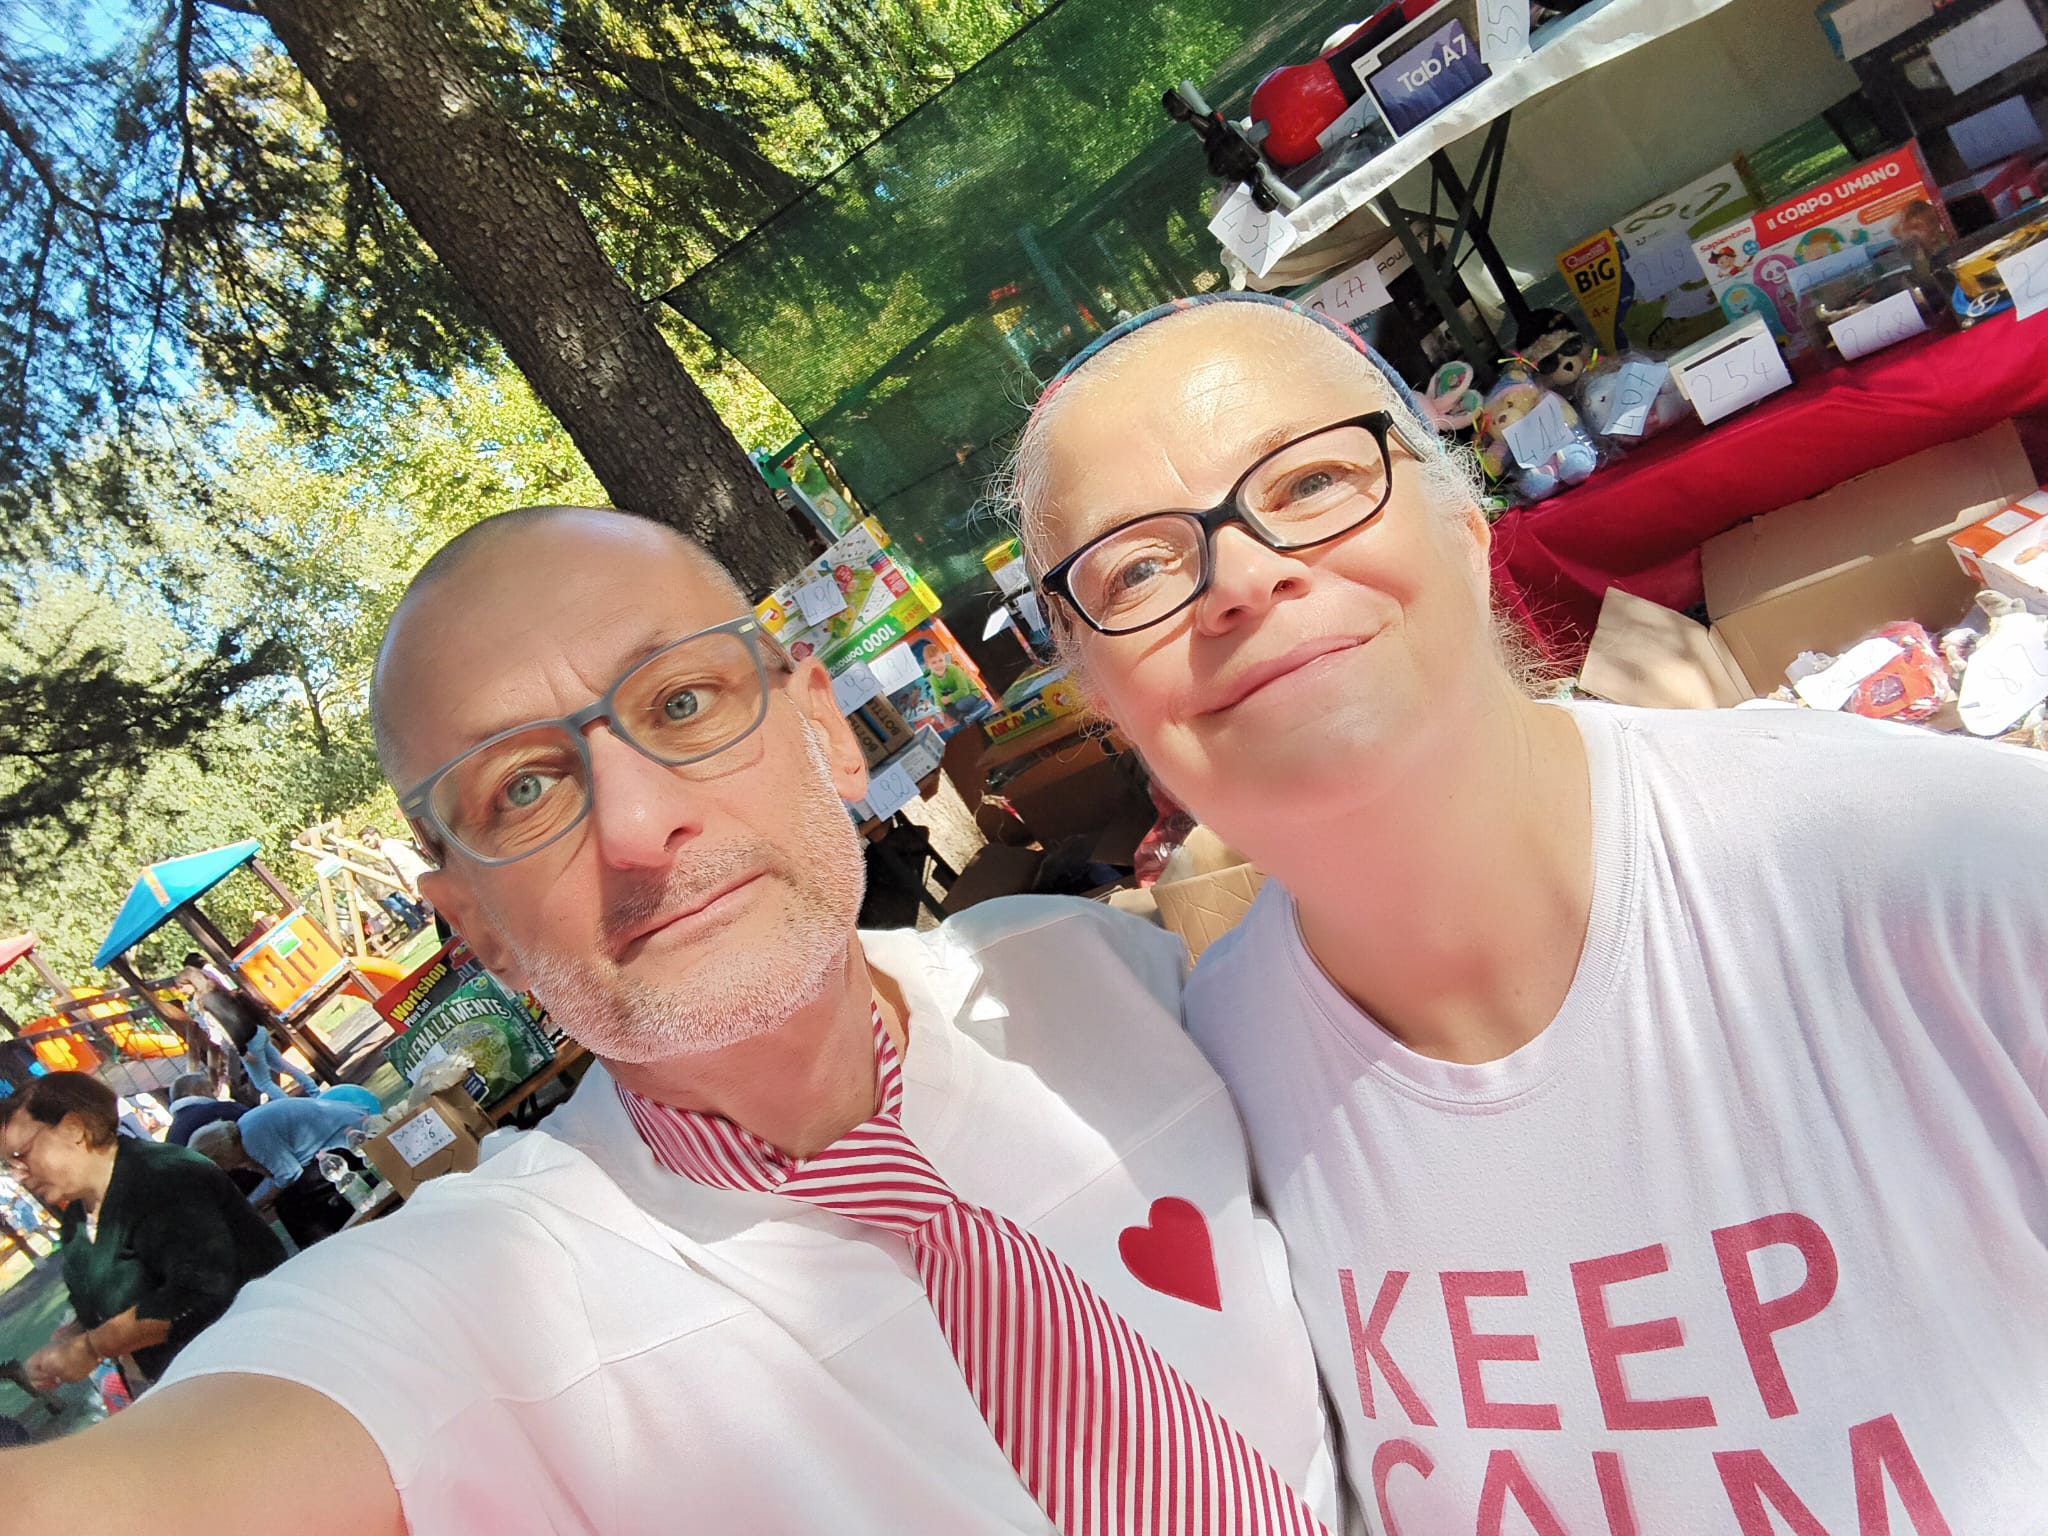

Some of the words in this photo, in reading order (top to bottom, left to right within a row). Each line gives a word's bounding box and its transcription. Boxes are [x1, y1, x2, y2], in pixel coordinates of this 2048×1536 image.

[1397, 58, 1442, 93] Tab
[1443, 33, 1469, 69] A7
[1777, 192, 1833, 226] CORPO
[1834, 161, 1901, 199] UMANO
[1222, 200, 1285, 258] 437
[1335, 275, 1367, 309] 477
[1574, 257, 1616, 294] BiG
[1690, 349, 1775, 403] 254
[862, 623, 897, 651] 1000
[390, 961, 448, 1022] Workshop
[403, 1006, 423, 1028] Play
[417, 998, 432, 1014] Set
[432, 1012, 456, 1035] LA
[449, 998, 512, 1024] MENTE
[1337, 1210, 1839, 1431] KEEP
